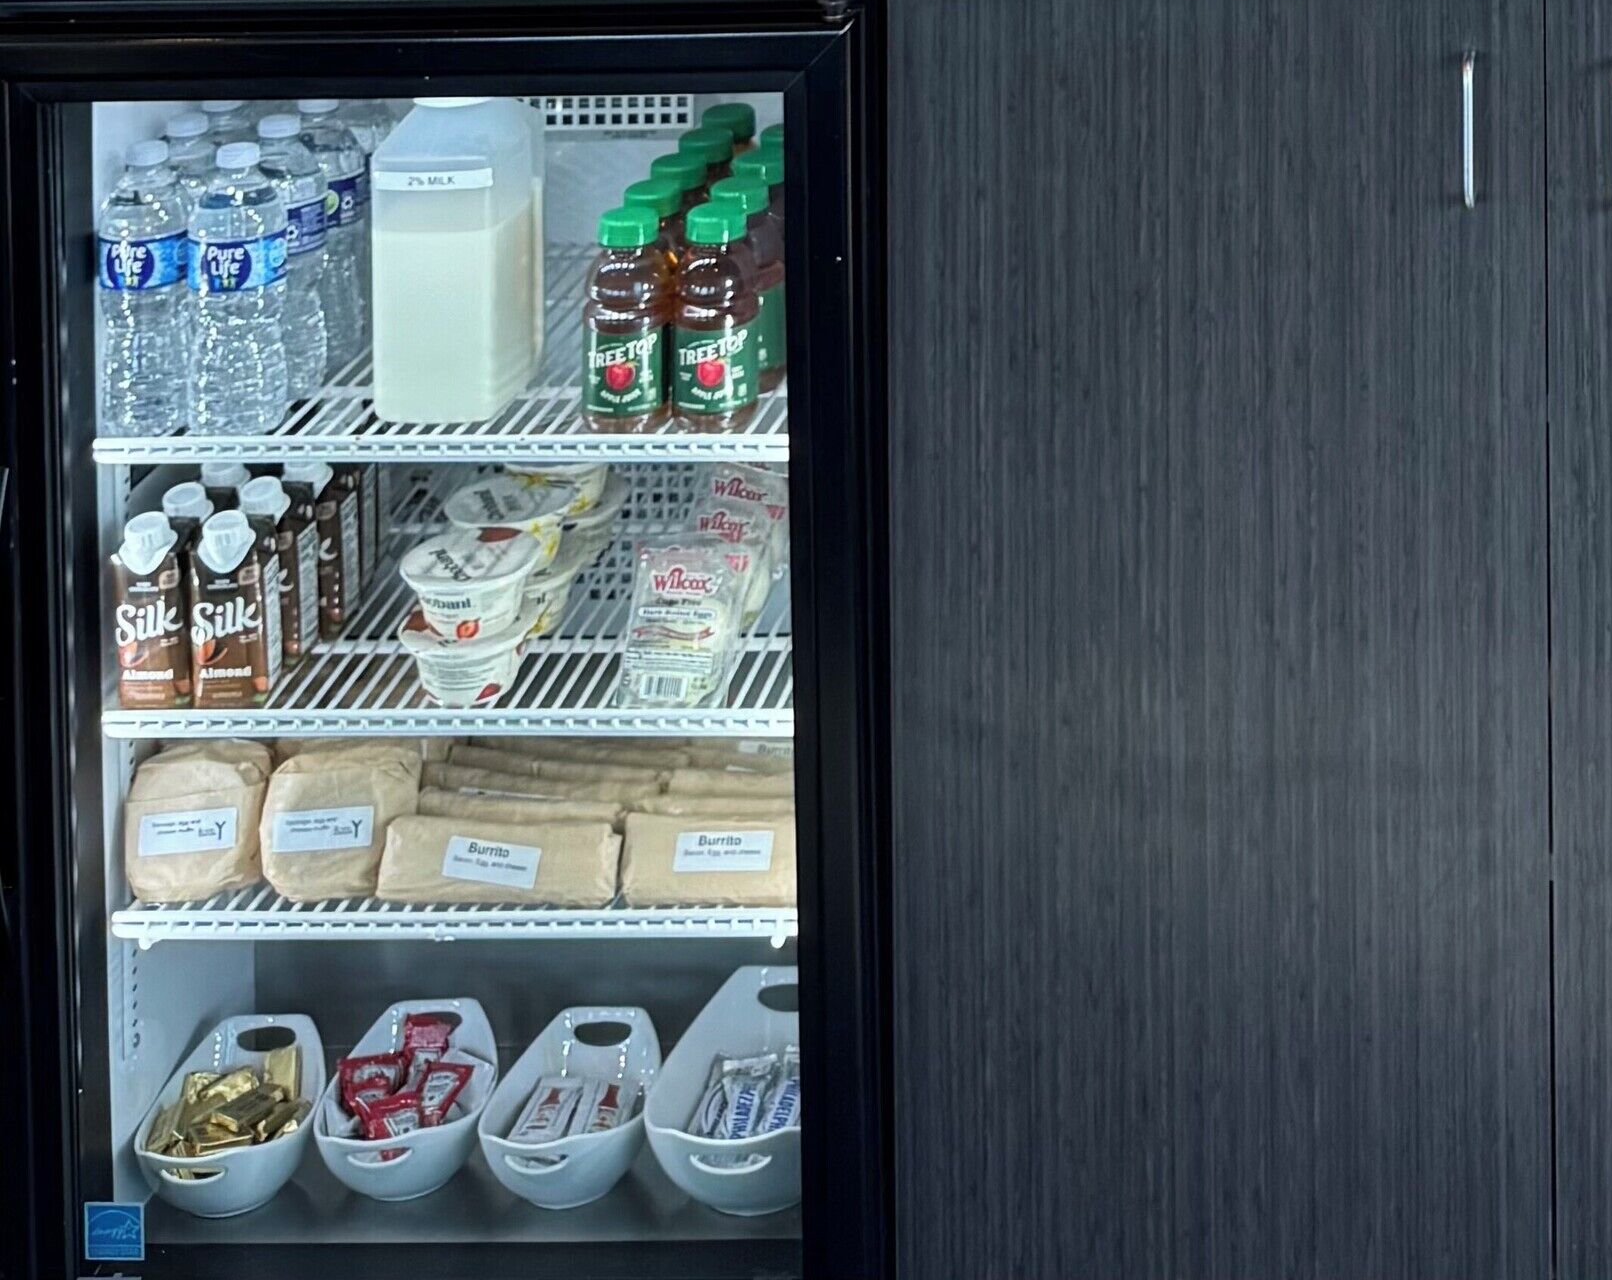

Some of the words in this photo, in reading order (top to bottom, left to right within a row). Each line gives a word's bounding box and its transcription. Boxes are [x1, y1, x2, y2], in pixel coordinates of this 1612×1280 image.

[408, 176, 425, 186] 2%
[428, 176, 456, 186] MILK
[207, 246, 245, 261] Pure
[211, 261, 243, 279] Life
[714, 477, 768, 502] Wilcox
[654, 567, 713, 594] Wilcox
[115, 599, 184, 647] Silk
[191, 596, 263, 647] Silk
[122, 668, 174, 681] Almond
[200, 665, 252, 679] Almond
[215, 820, 227, 840] Y
[351, 819, 363, 838] Y
[698, 834, 742, 847] Burrito
[467, 842, 510, 859] Burrito
